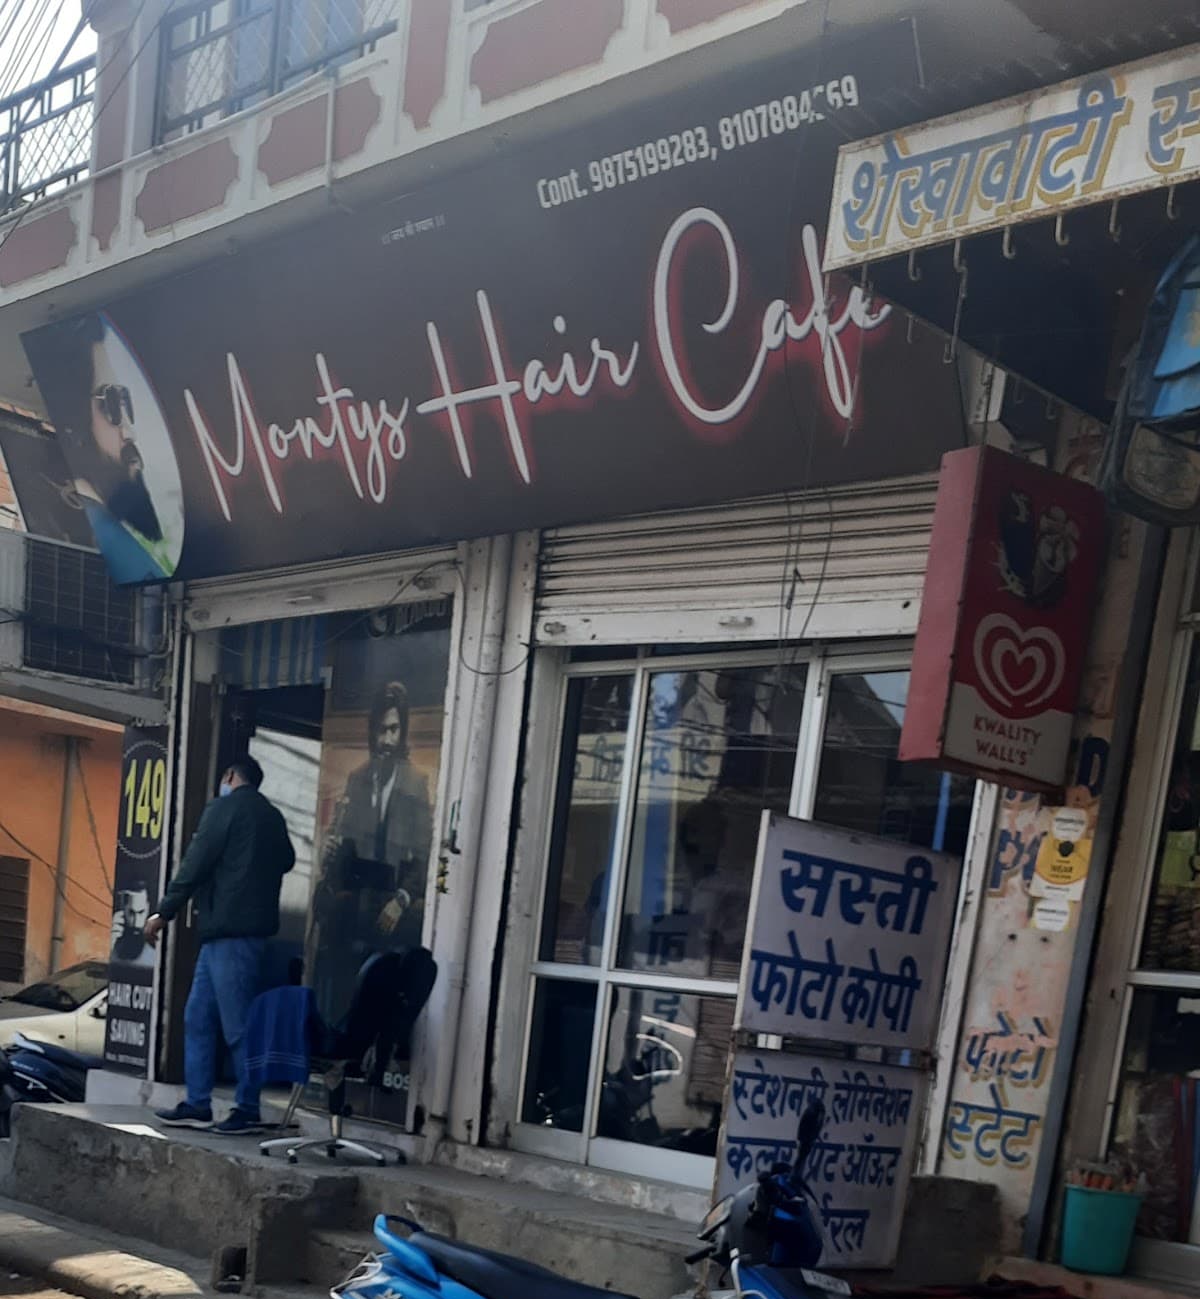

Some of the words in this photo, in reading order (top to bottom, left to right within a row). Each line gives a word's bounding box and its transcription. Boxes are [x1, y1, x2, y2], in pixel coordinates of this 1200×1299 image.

[536, 169, 588, 208] Cont.
[589, 126, 717, 192] 9875199283,
[842, 72, 1132, 251] शेखावाटी
[184, 352, 408, 522] Montys
[416, 289, 639, 484] Hair
[973, 714, 1042, 745] KWALITY
[976, 739, 1028, 766] WALL'S
[125, 758, 165, 840] 149
[781, 849, 938, 935] सस्ती
[751, 930, 844, 1022] फोटो
[840, 948, 922, 1034] कोपी
[947, 1083, 1042, 1169] स्टेट
